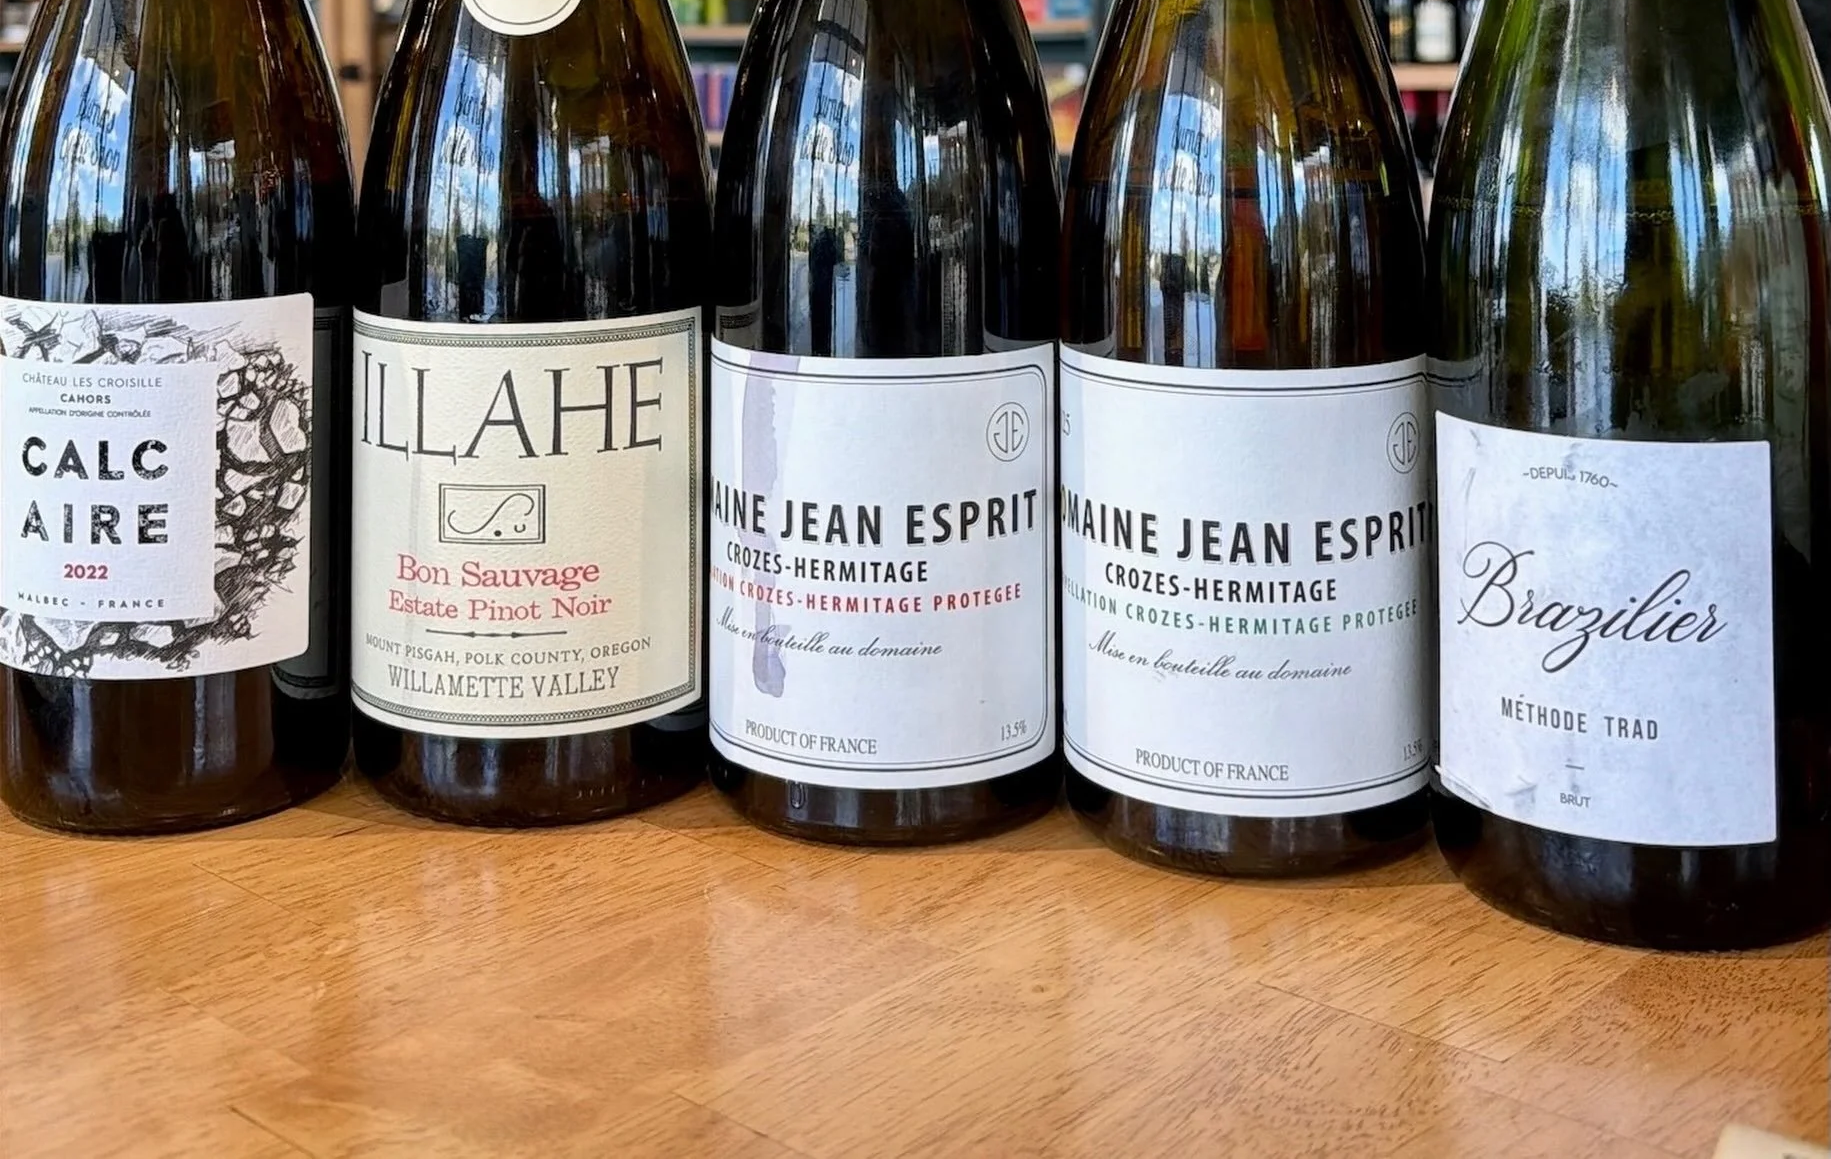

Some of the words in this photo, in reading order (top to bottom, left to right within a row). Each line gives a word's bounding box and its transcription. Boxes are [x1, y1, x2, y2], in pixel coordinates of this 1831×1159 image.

[22, 372, 67, 387] CHÂTEAU
[72, 376, 93, 388] LES
[97, 376, 163, 388] CROISILLE
[60, 393, 112, 404] CAHORS
[28, 406, 67, 417] APPELLATION
[360, 349, 664, 467] ILLAHE
[21, 435, 169, 481] CALC
[20, 499, 169, 545] AIRE
[780, 499, 883, 546] JEAN
[906, 487, 1037, 547] ESPRIT
[1176, 517, 1292, 566] JEAN
[1314, 500, 1427, 565] ESPRIT
[63, 563, 109, 580] 2022
[396, 553, 451, 588] Bon
[460, 560, 600, 592] Sauvage
[726, 540, 929, 584] CROZES-HERMITAGE
[18, 592, 69, 607] MALBEC
[98, 599, 165, 609] FRANCE
[739, 579, 923, 615] CROZES-HERMITAGE
[1105, 561, 1337, 604] CROZES-HERMITAGE
[388, 589, 459, 619] Estate
[467, 598, 541, 621] Pinot
[551, 594, 613, 619] Noir
[1125, 602, 1333, 636] CROZES-HERMITAGE
[1457, 540, 1729, 674] Brazilier
[366, 632, 401, 657] MOUNT
[404, 645, 461, 667] PISGAH,
[465, 651, 505, 667] POLK
[510, 648, 585, 666] COUNTY,
[589, 636, 652, 660] OREGON
[715, 605, 740, 636] Mise
[741, 630, 757, 641] en
[759, 624, 830, 654] bouteille
[828, 645, 854, 657] au
[857, 636, 944, 657] domaine
[1088, 628, 1126, 662] Mise
[1128, 653, 1150, 668] en
[1153, 648, 1232, 680] bouteille
[1234, 667, 1264, 681] au
[1267, 660, 1353, 680] domaine
[387, 663, 524, 699] WILLAMETTE
[531, 664, 621, 698] VALLEY
[1501, 693, 1589, 734] MÉTHODE
[1603, 715, 1660, 741] TRAD
[745, 718, 798, 751] PRODUCT
[799, 732, 818, 751] OF
[819, 734, 878, 755] FRANCE
[1135, 747, 1201, 777] PRODUCT
[1203, 760, 1225, 779] OF
[1226, 761, 1290, 782] FRANCE
[1559, 791, 1592, 809] BRUT
